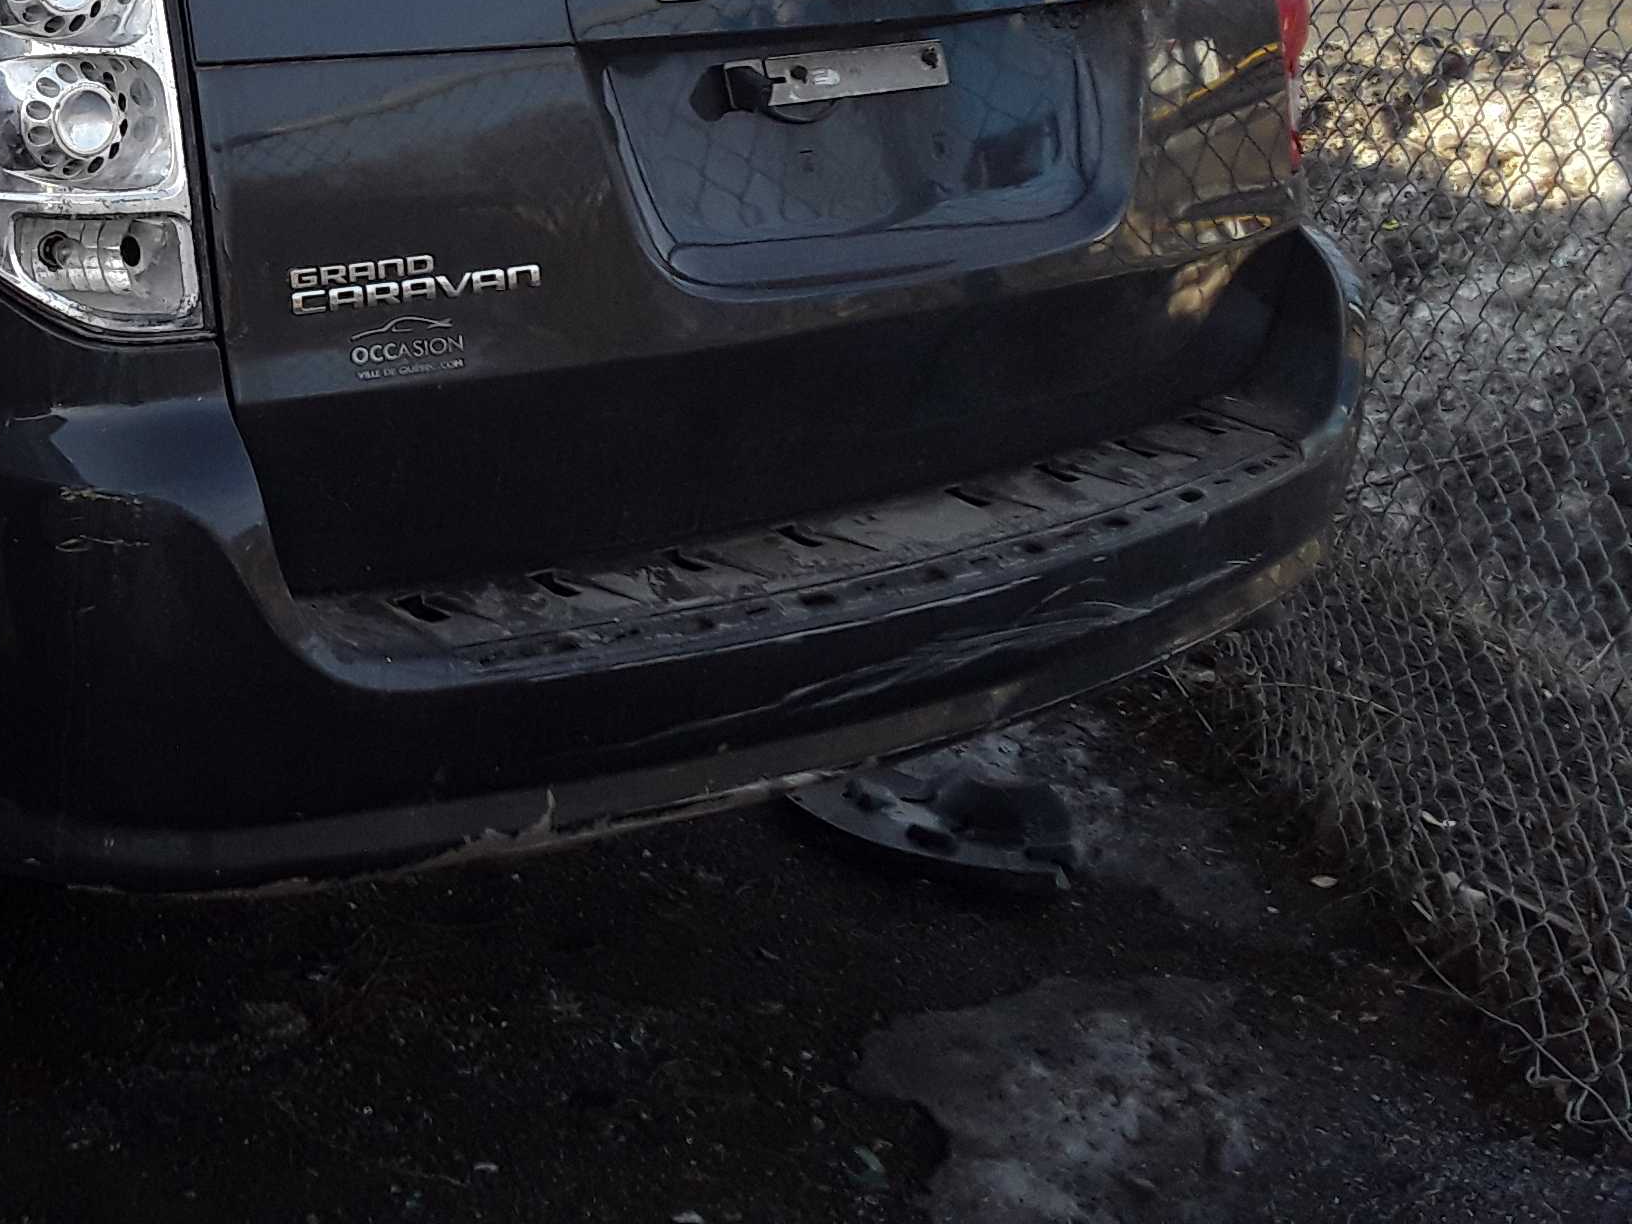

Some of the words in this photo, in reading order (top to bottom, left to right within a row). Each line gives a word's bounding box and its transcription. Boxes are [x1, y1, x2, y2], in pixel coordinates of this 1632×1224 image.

[288, 253, 435, 290] GRAND
[289, 263, 543, 317] CARAVAN
[350, 334, 465, 366] OCCASION
